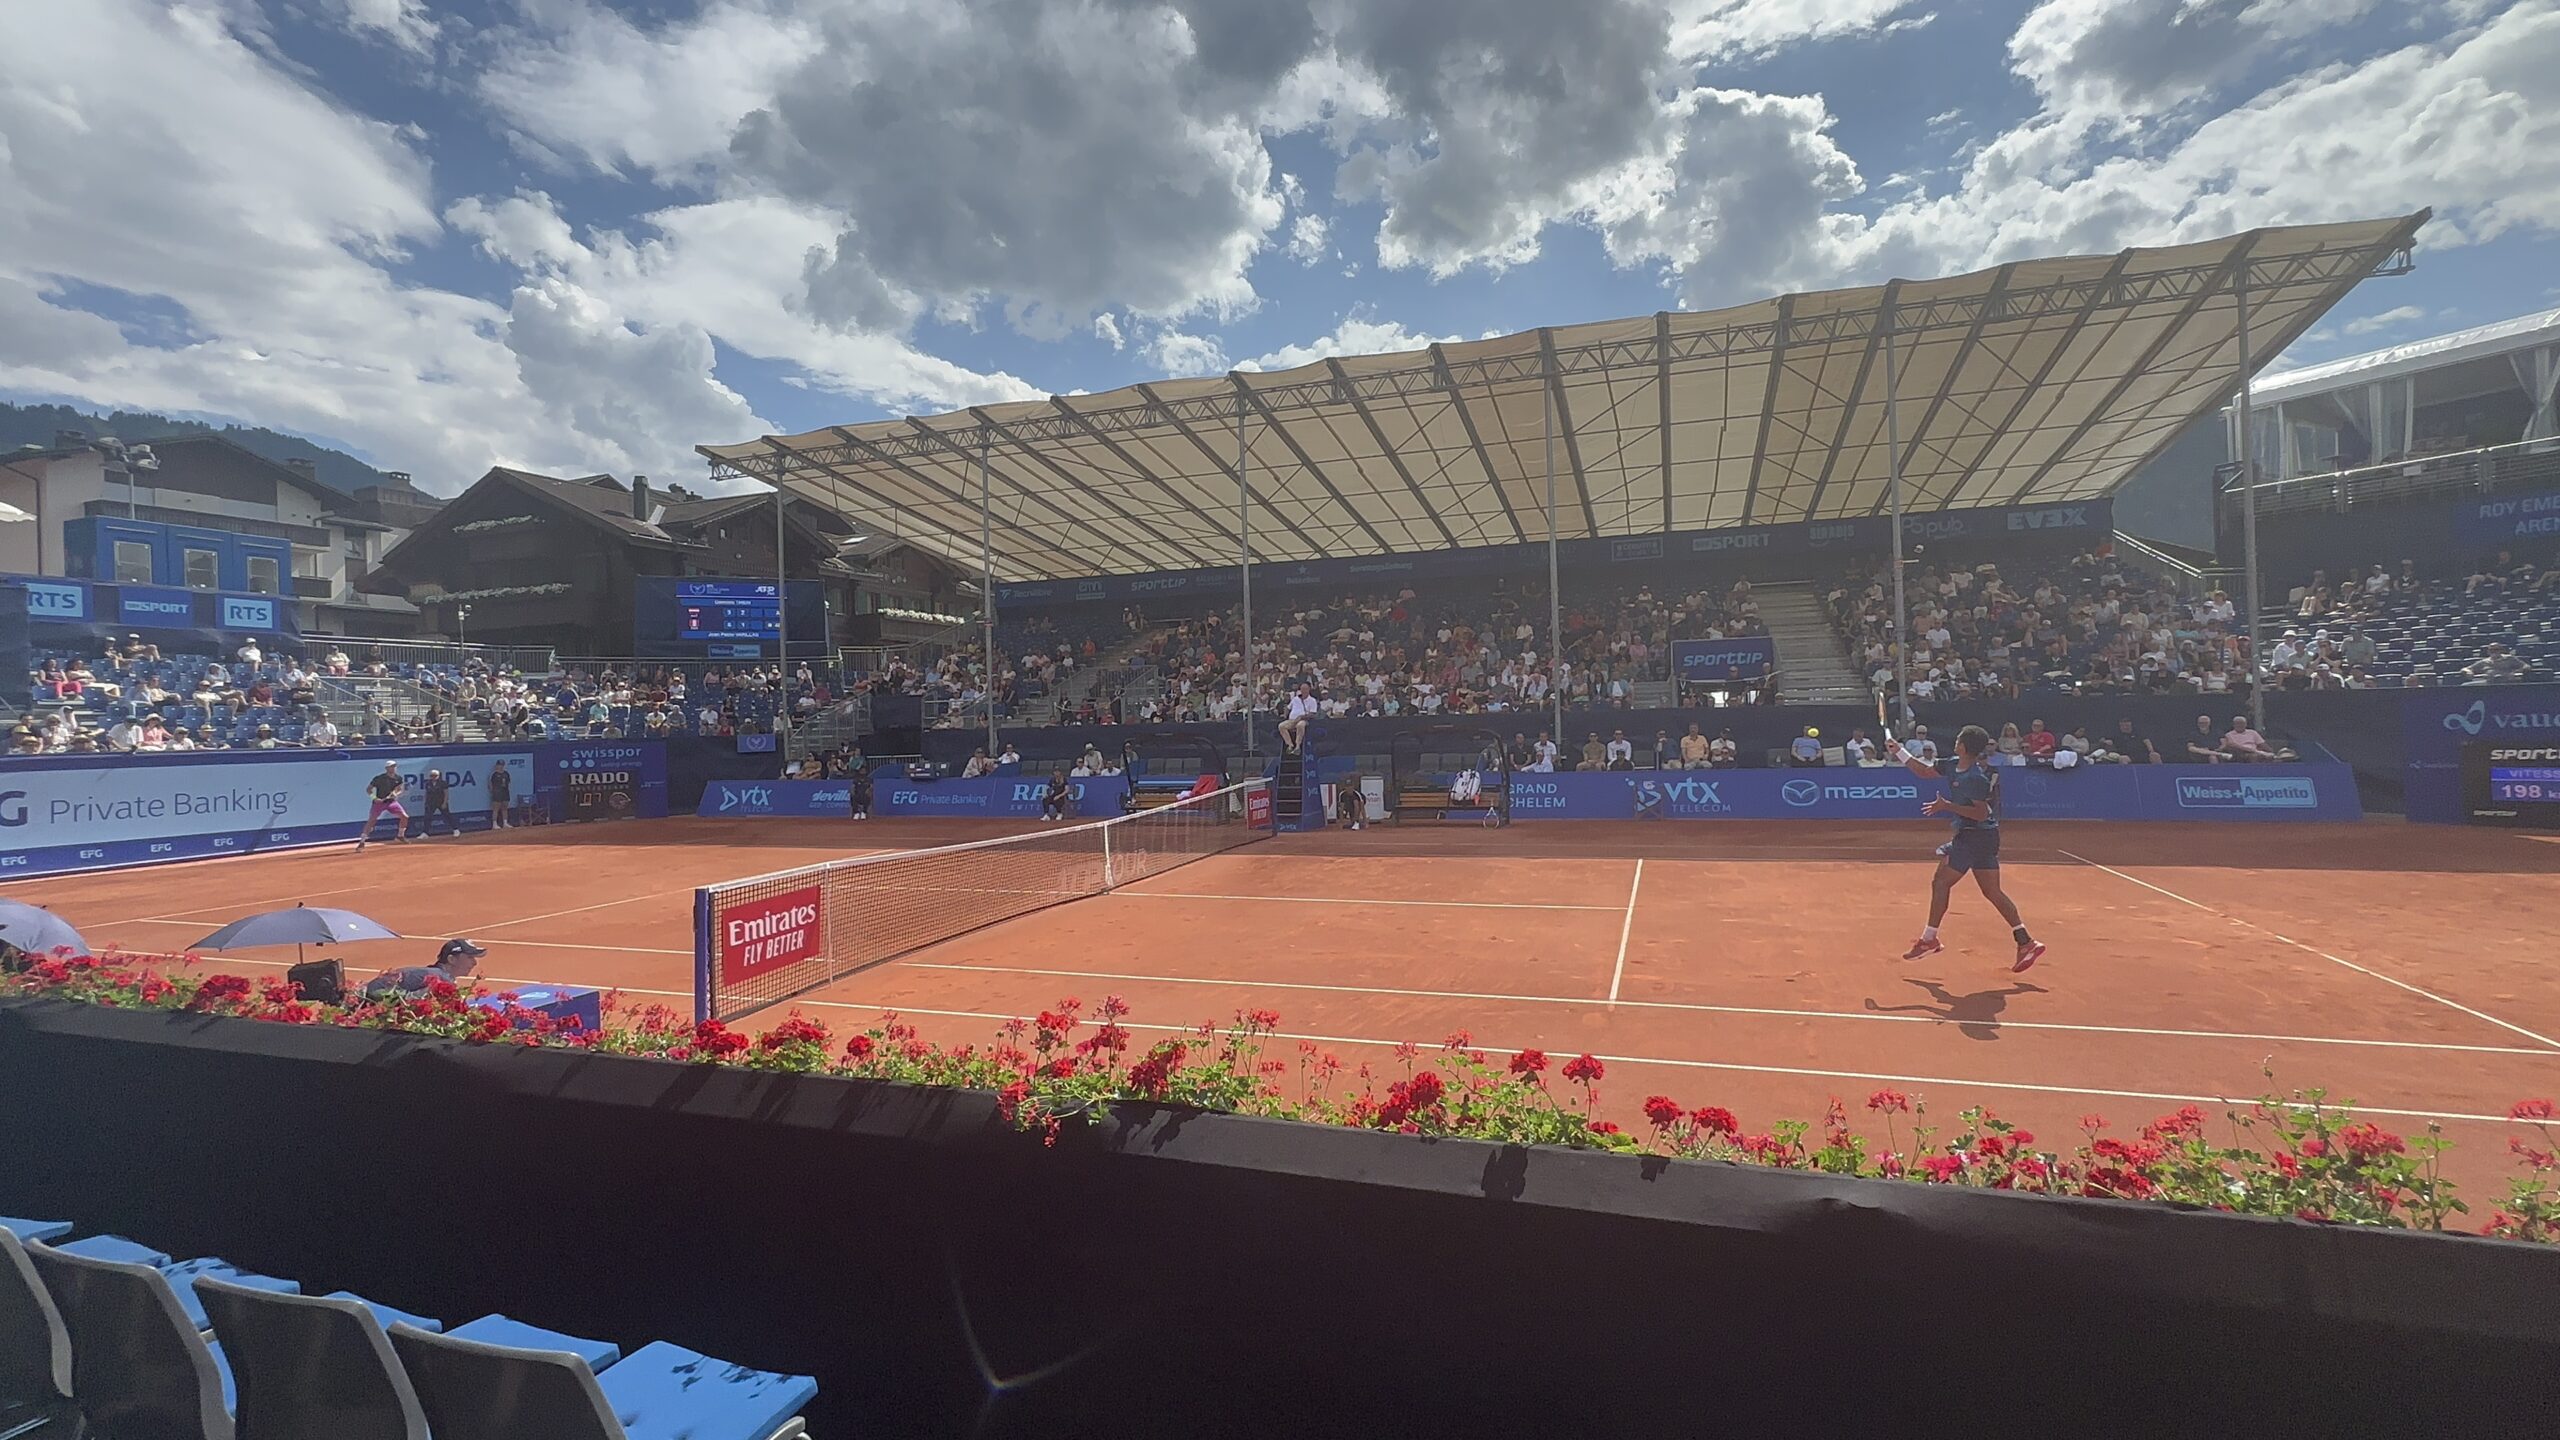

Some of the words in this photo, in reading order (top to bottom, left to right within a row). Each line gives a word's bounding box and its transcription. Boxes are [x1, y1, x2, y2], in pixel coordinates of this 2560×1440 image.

[2480, 501, 2517, 518] ROY
[1713, 533, 1770, 550] SPORT
[28, 591, 77, 609] RTS
[140, 602, 188, 614] SPORT
[229, 606, 268, 621] RTS
[572, 746, 642, 760] swisspor
[2491, 748, 2560, 760] sport
[570, 771, 629, 784] RADO
[2182, 786, 2308, 801] Weiss+Appetito
[2502, 784, 2542, 798] 198
[50, 796, 165, 824] Private
[174, 787, 288, 816] Banking
[892, 791, 918, 804] EFG
[921, 793, 951, 805] Private
[952, 793, 987, 806] Banking
[1672, 804, 1731, 813] TELECOM
[214, 838, 234, 847] EFG
[271, 833, 290, 841] EFG
[80, 849, 103, 859] EFG
[151, 842, 172, 852] EFG
[1, 856, 27, 866] EFG
[729, 903, 817, 947] Emirates
[743, 941, 763, 967] FLY
[766, 929, 805, 960] BETTER
